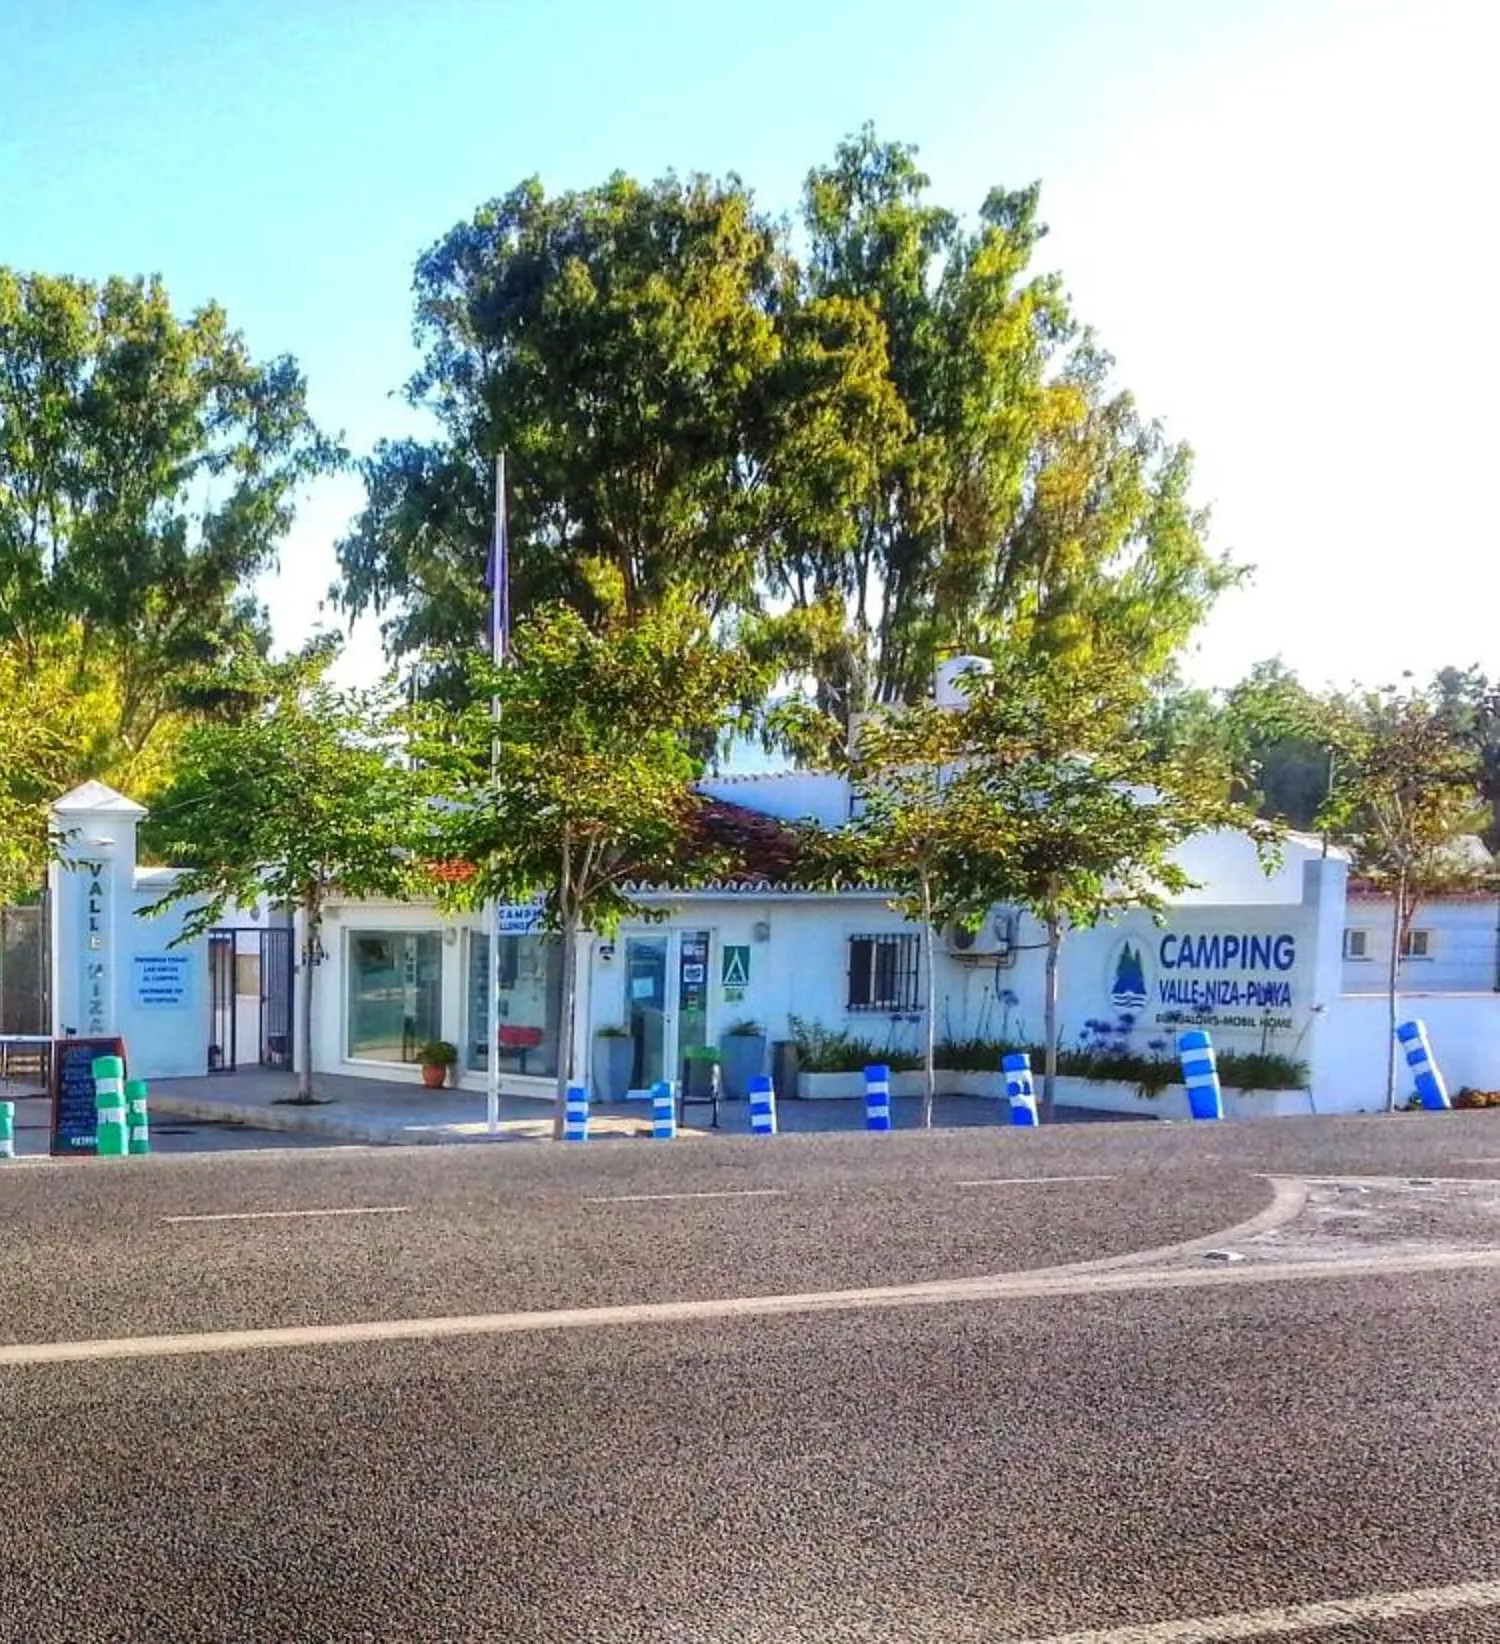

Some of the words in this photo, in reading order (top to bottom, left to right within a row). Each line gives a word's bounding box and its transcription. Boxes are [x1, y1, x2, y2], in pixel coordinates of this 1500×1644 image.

[88, 863, 103, 951] VALLE
[1159, 933, 1295, 971] CAMPING
[1159, 978, 1293, 1008] VALLE-NIZA-PLAYA
